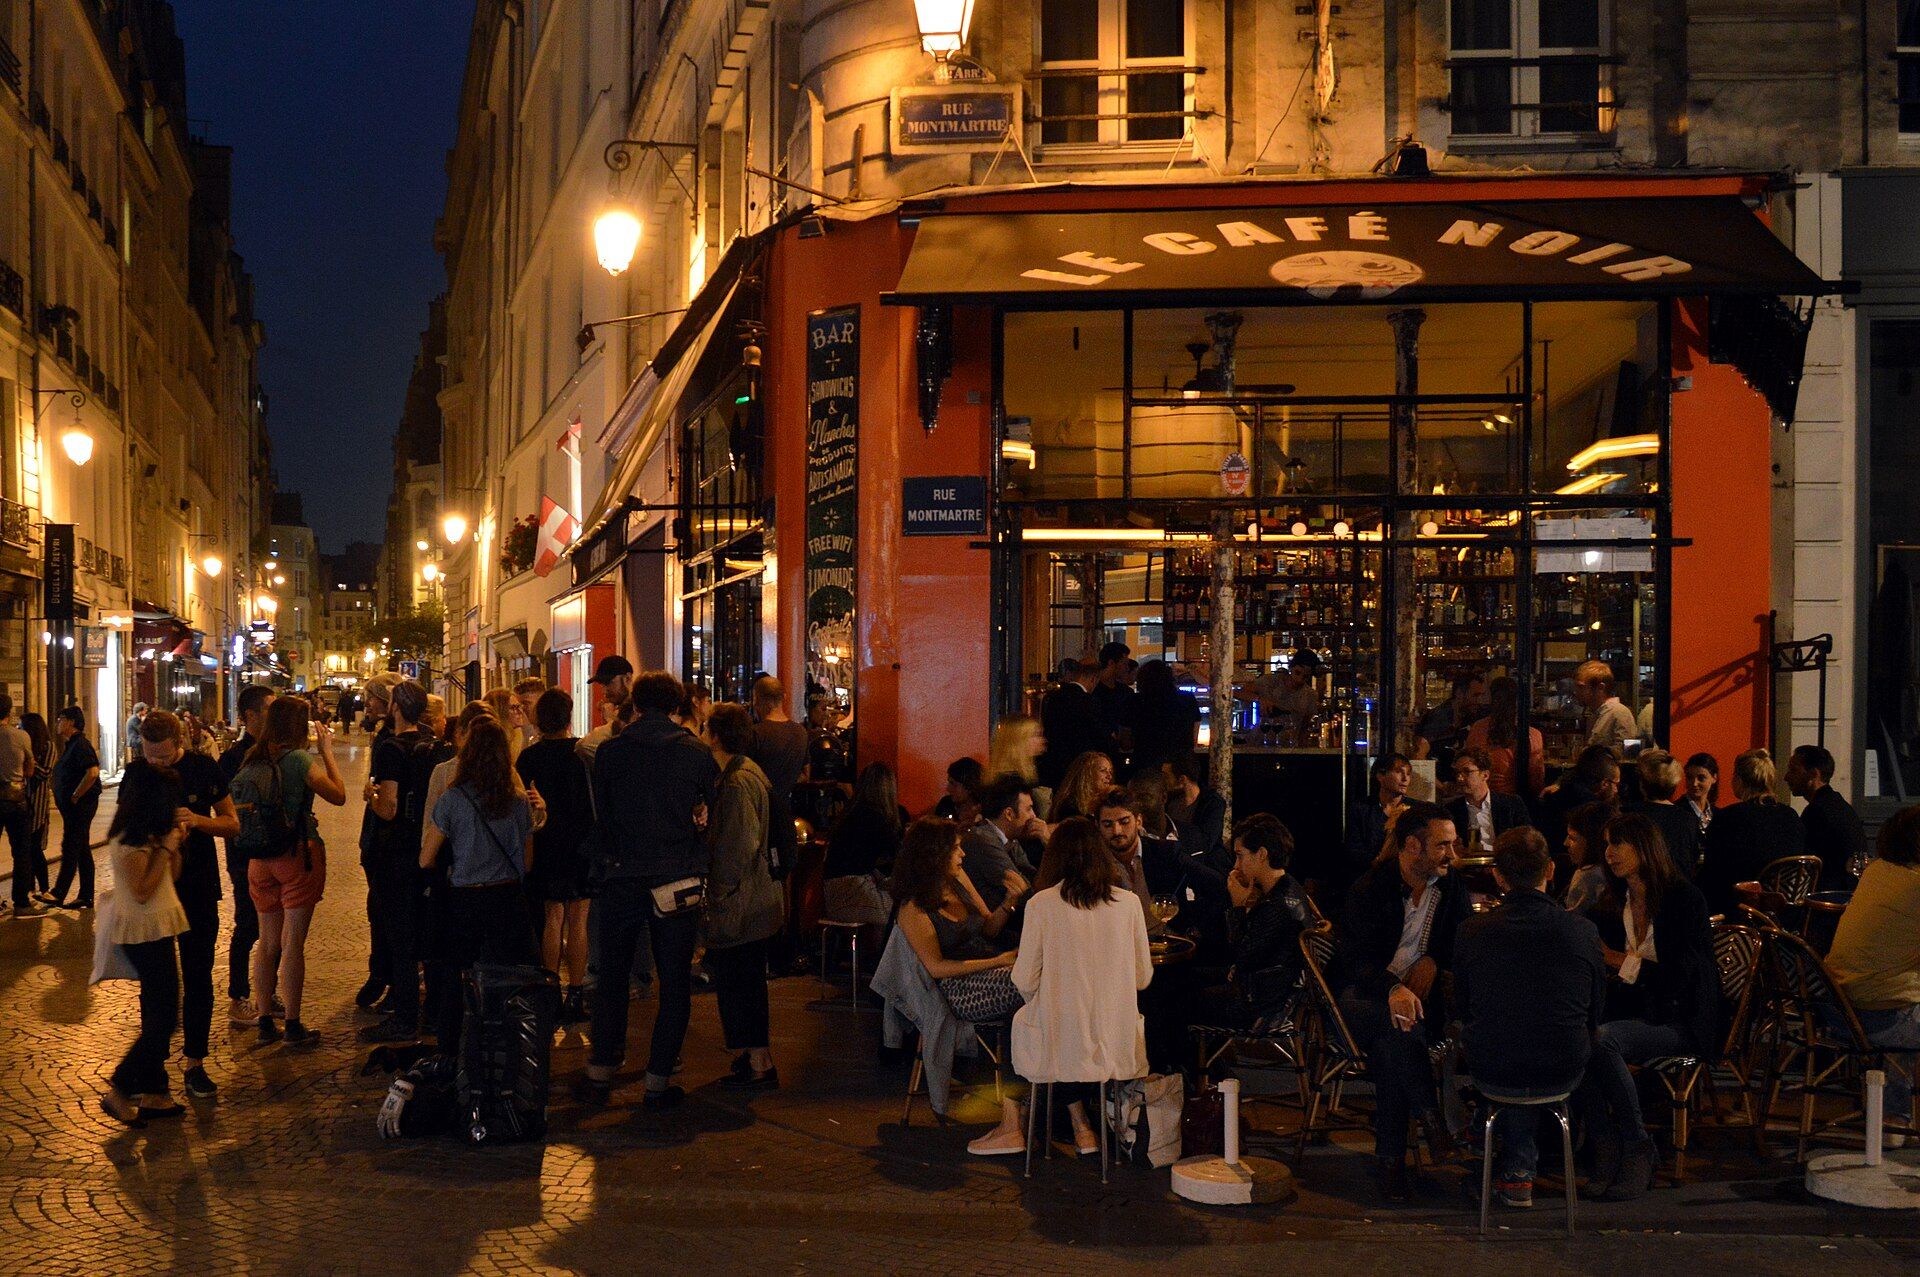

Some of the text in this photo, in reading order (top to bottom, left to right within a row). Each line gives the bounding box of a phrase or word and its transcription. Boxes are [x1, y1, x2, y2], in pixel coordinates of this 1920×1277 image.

[942, 103, 973, 116] RUE
[907, 119, 1008, 134] MONTMARTRE
[1020, 211, 1694, 286] LE CAFÉ NOIR
[812, 322, 855, 350] BAR
[827, 400, 839, 415] &
[809, 413, 856, 452] Planches
[809, 444, 856, 466] PRODUITS
[808, 459, 855, 493] ARTISANAUX
[933, 488, 956, 501] RUE
[907, 509, 983, 522] MONTMARTRE
[808, 567, 854, 599] LIMONADE
[806, 661, 853, 685] VINS
